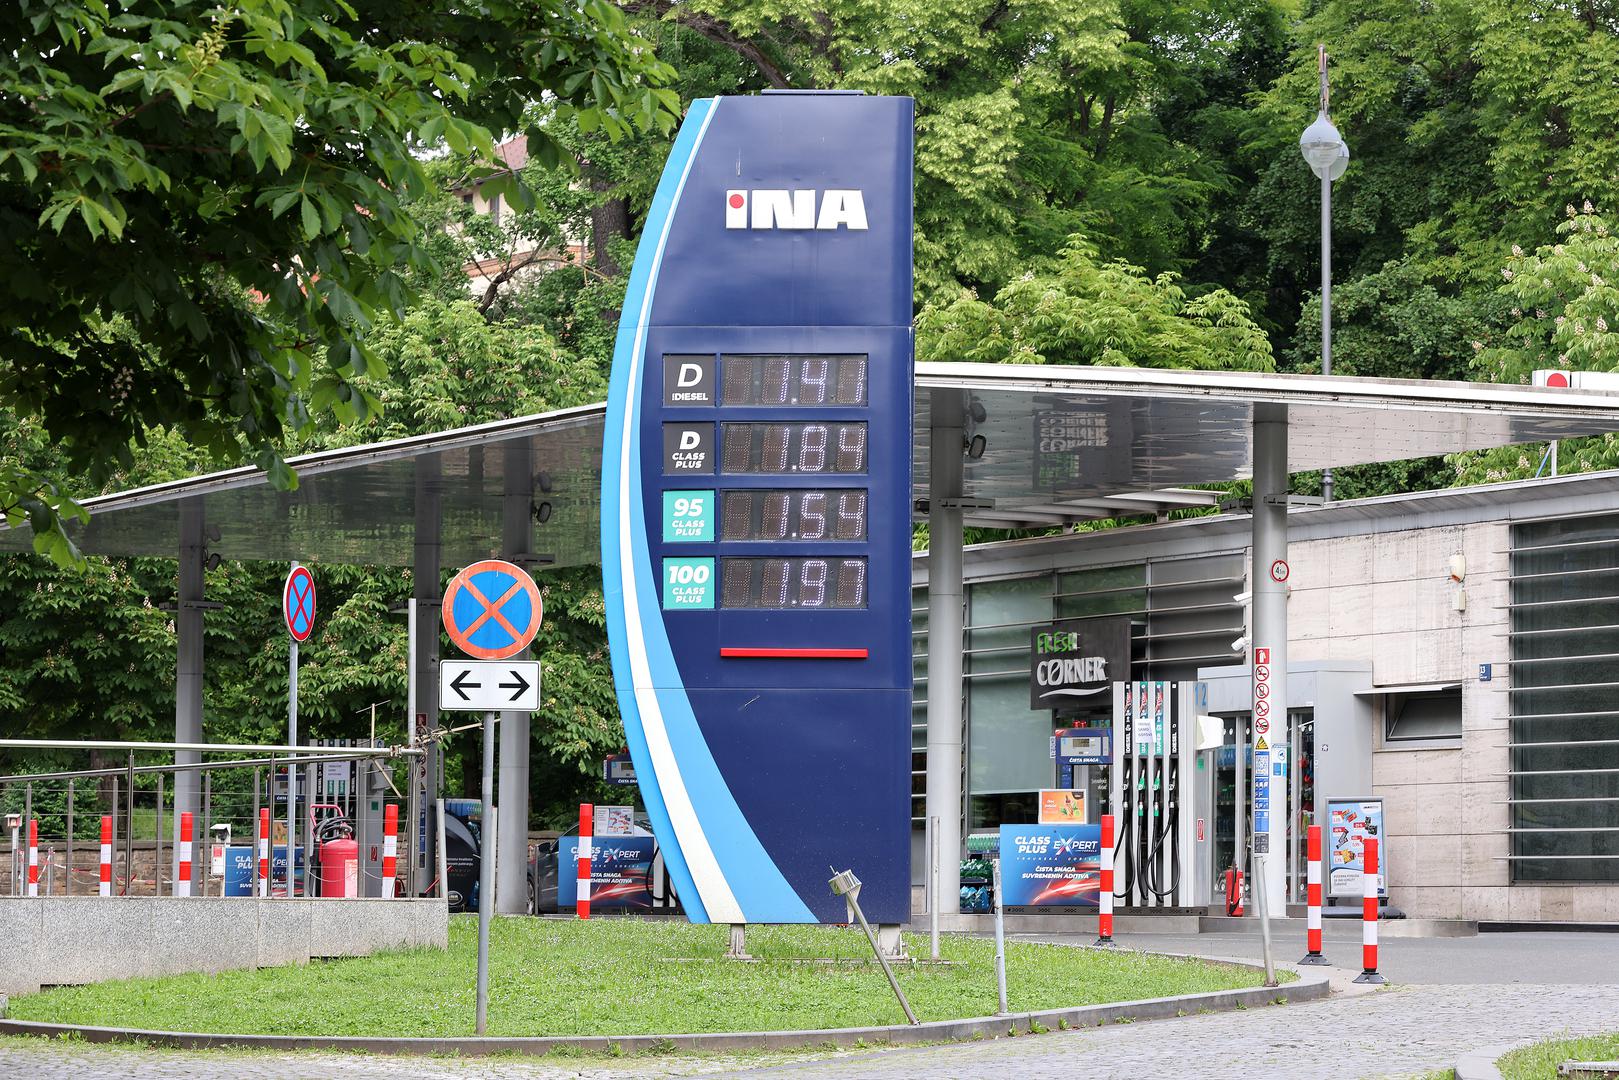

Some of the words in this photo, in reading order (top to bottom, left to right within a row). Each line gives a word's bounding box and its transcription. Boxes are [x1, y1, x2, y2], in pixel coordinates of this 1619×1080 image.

[726, 190, 869, 230] INA
[677, 363, 703, 387] D
[780, 360, 866, 404] 1.41
[680, 431, 701, 450] D
[780, 426, 866, 471] 1.84
[672, 453, 705, 461] CLASS
[675, 461, 702, 469] PLUS
[673, 498, 704, 517] 95
[780, 493, 866, 539] 1.54
[672, 520, 705, 528] CLASS
[675, 528, 702, 536] PLUS
[669, 565, 710, 584] 100
[780, 560, 866, 606] 1.97
[672, 587, 705, 595] CLASS
[675, 595, 702, 603] PLUS
[1037, 656, 1107, 686] CORNER
[1015, 836, 1051, 845] CLASS
[1053, 838, 1098, 855] EXPERT
[571, 846, 601, 854] CSS
[602, 848, 641, 863] EXPERT
[1018, 845, 1048, 854] PLUS
